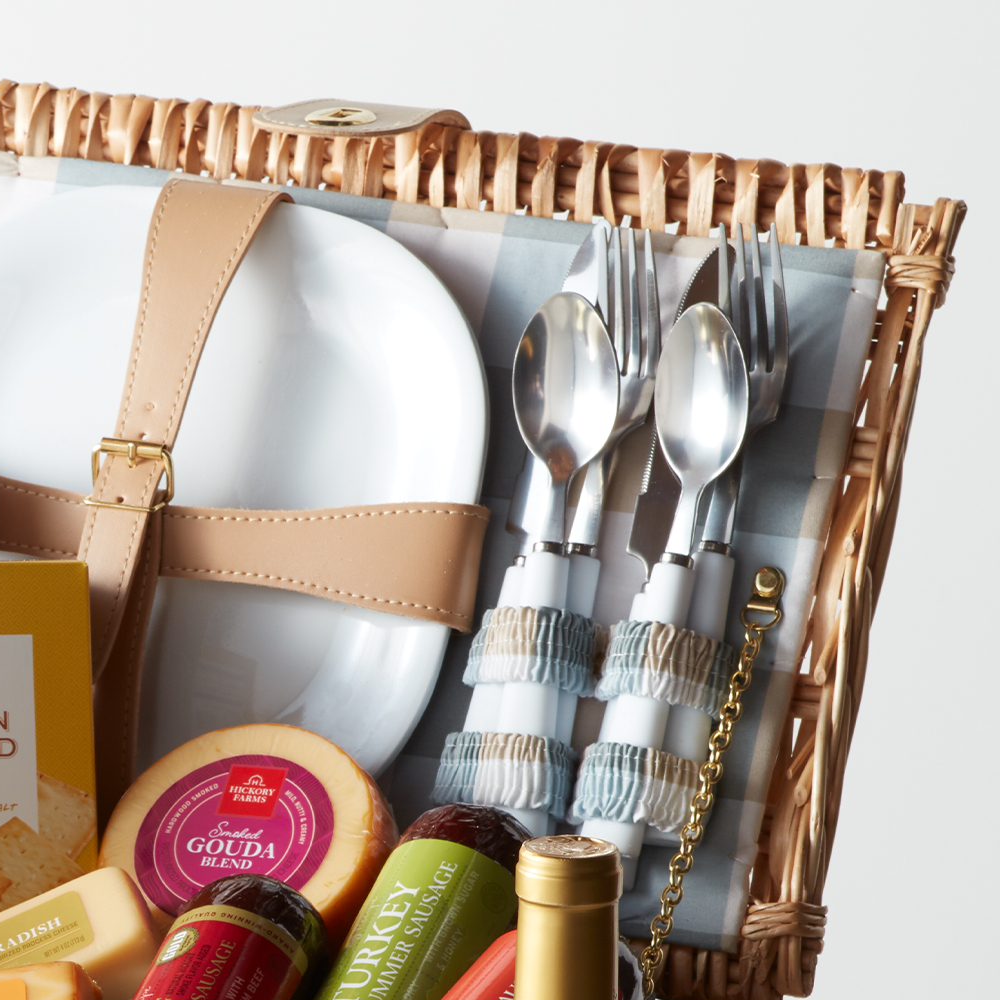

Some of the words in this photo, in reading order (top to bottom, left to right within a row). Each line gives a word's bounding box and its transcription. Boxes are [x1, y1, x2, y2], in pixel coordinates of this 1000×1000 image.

[229, 785, 276, 797] HICKORY
[232, 794, 268, 804] FARMS
[165, 800, 192, 834] HARDWOOD
[192, 782, 219, 802] SMOKED
[294, 802, 306, 818] NUTTY
[208, 820, 263, 840] Smoked
[298, 822, 308, 846] CREAMY
[186, 837, 276, 860] GOUDA
[200, 856, 253, 870] BLEND
[404, 860, 458, 938] SAUSAGE
[180, 911, 217, 924] QUALITY
[426, 939, 443, 963] WITH
[441, 904, 462, 940] BROWN
[458, 870, 480, 904] SUGAR
[22, 932, 52, 950] PROCESS
[52, 920, 78, 936] CHEESE
[162, 930, 188, 962] GOLD
[436, 962, 445, 970] &
[441, 928, 464, 962] HONEY
[226, 976, 245, 1000] WITH
[249, 968, 264, 994] BEEF
